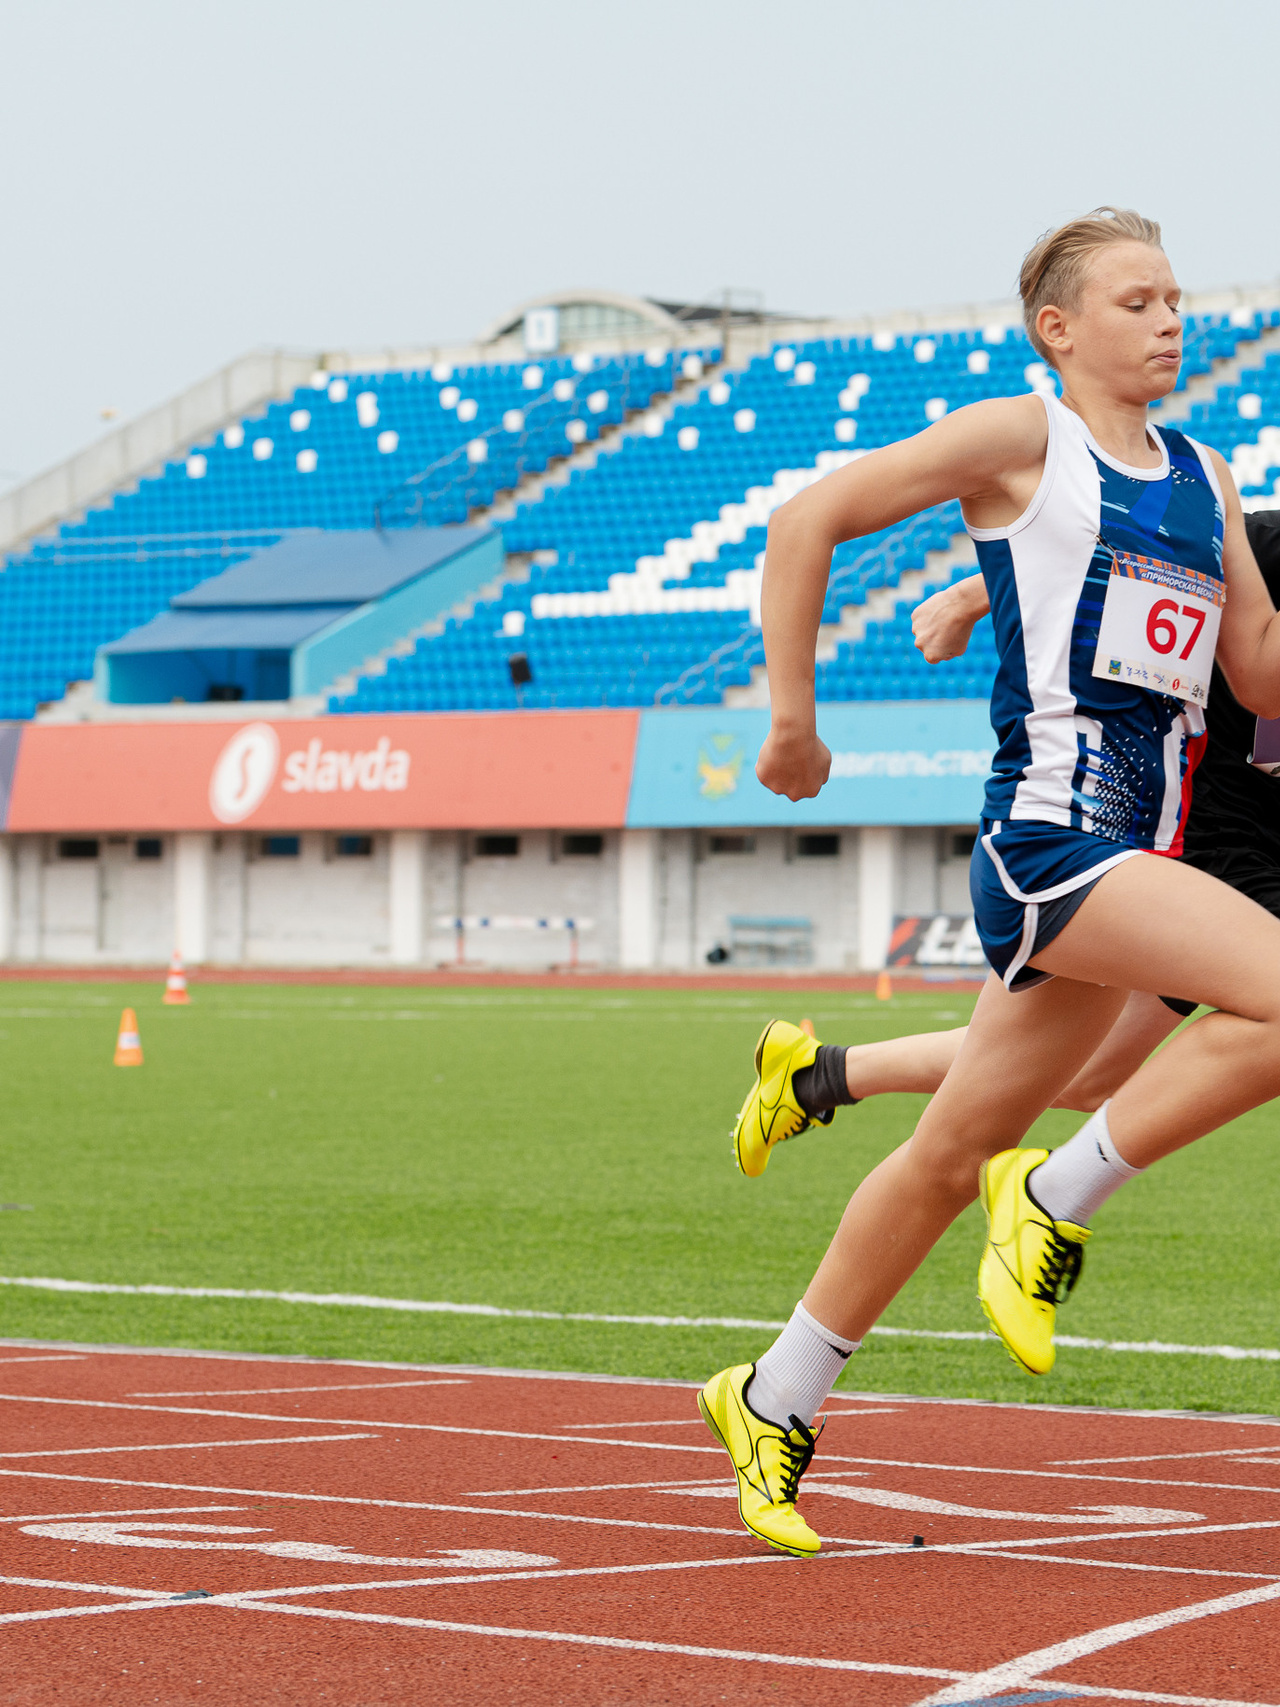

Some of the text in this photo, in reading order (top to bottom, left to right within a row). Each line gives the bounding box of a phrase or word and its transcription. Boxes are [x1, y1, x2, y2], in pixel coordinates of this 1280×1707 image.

[1141, 571, 1197, 593] «ПРИМОРСКАЯ
[1146, 598, 1206, 660] 67
[281, 737, 411, 793] slavda
